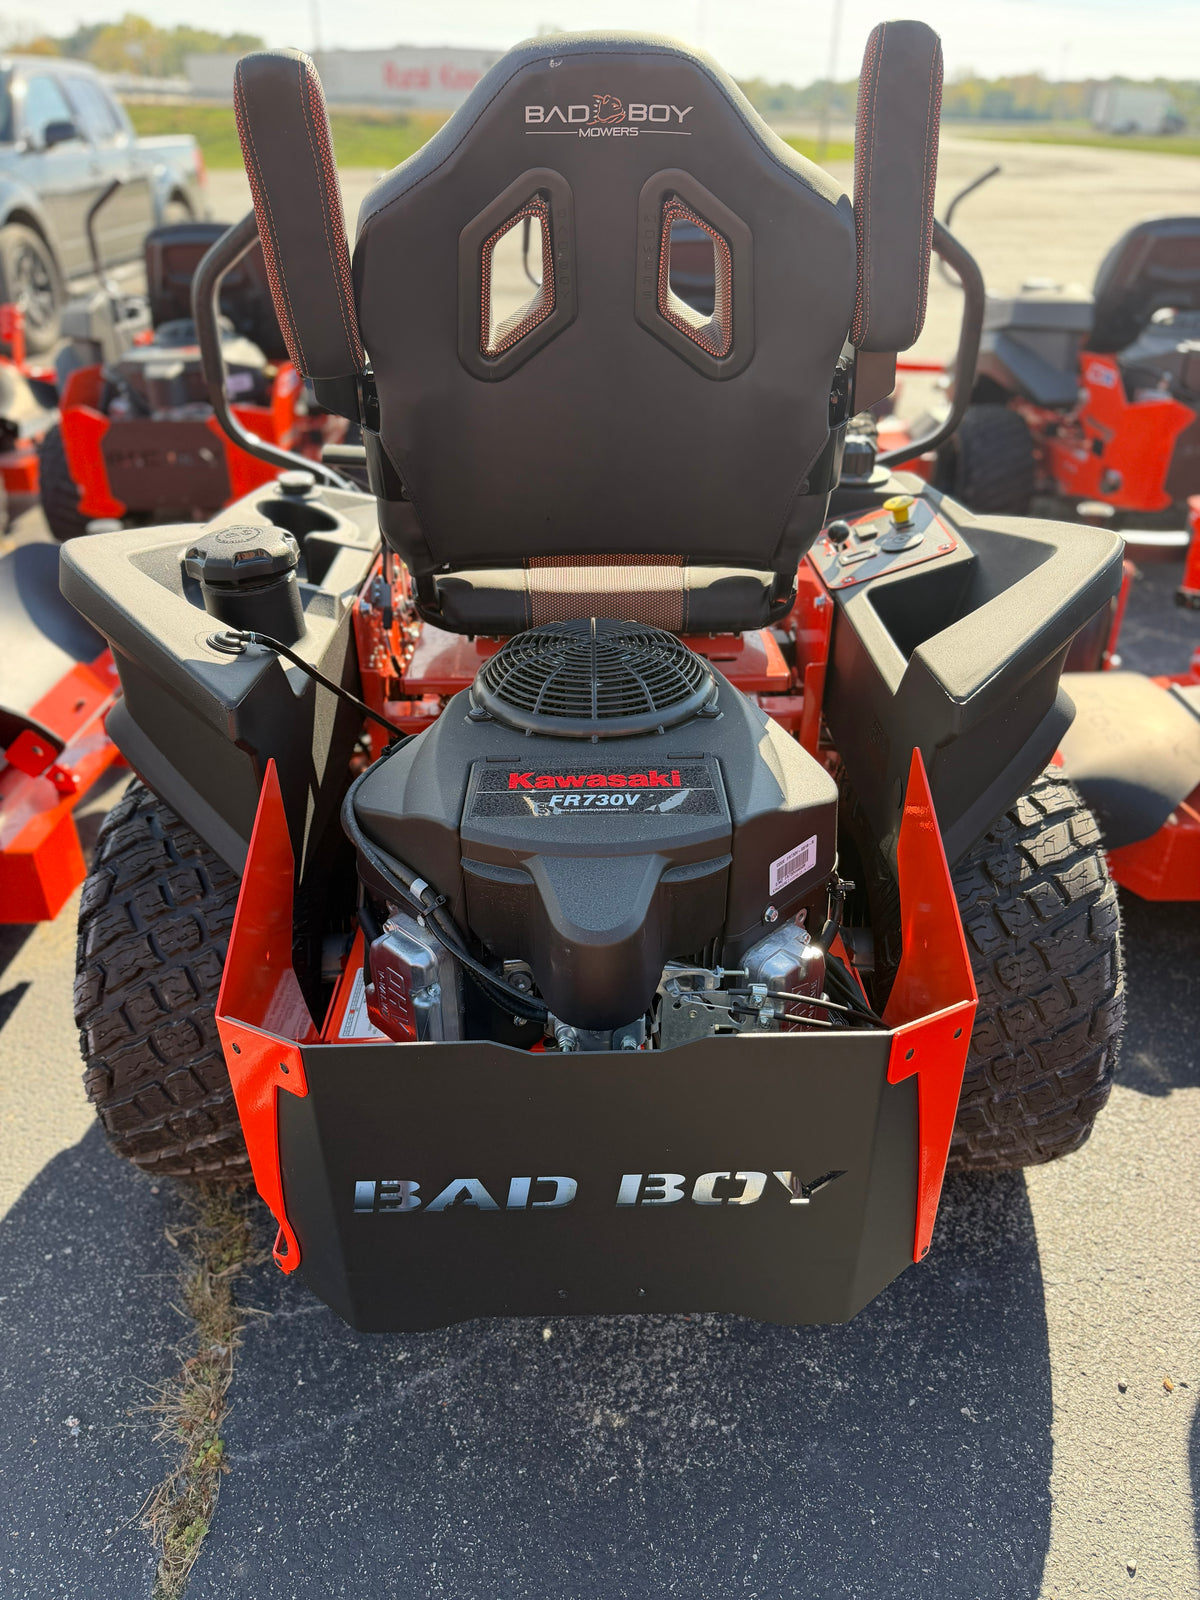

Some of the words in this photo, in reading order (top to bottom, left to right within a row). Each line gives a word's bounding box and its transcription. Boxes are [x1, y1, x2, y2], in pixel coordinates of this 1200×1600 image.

[525, 104, 590, 124] BAD
[628, 103, 694, 123] BOY
[578, 127, 639, 138] MOWERS
[508, 770, 681, 789] Kawasaki
[549, 794, 641, 807] FR730V
[353, 1175, 578, 1213] BAD
[616, 1169, 849, 1208] BOY
